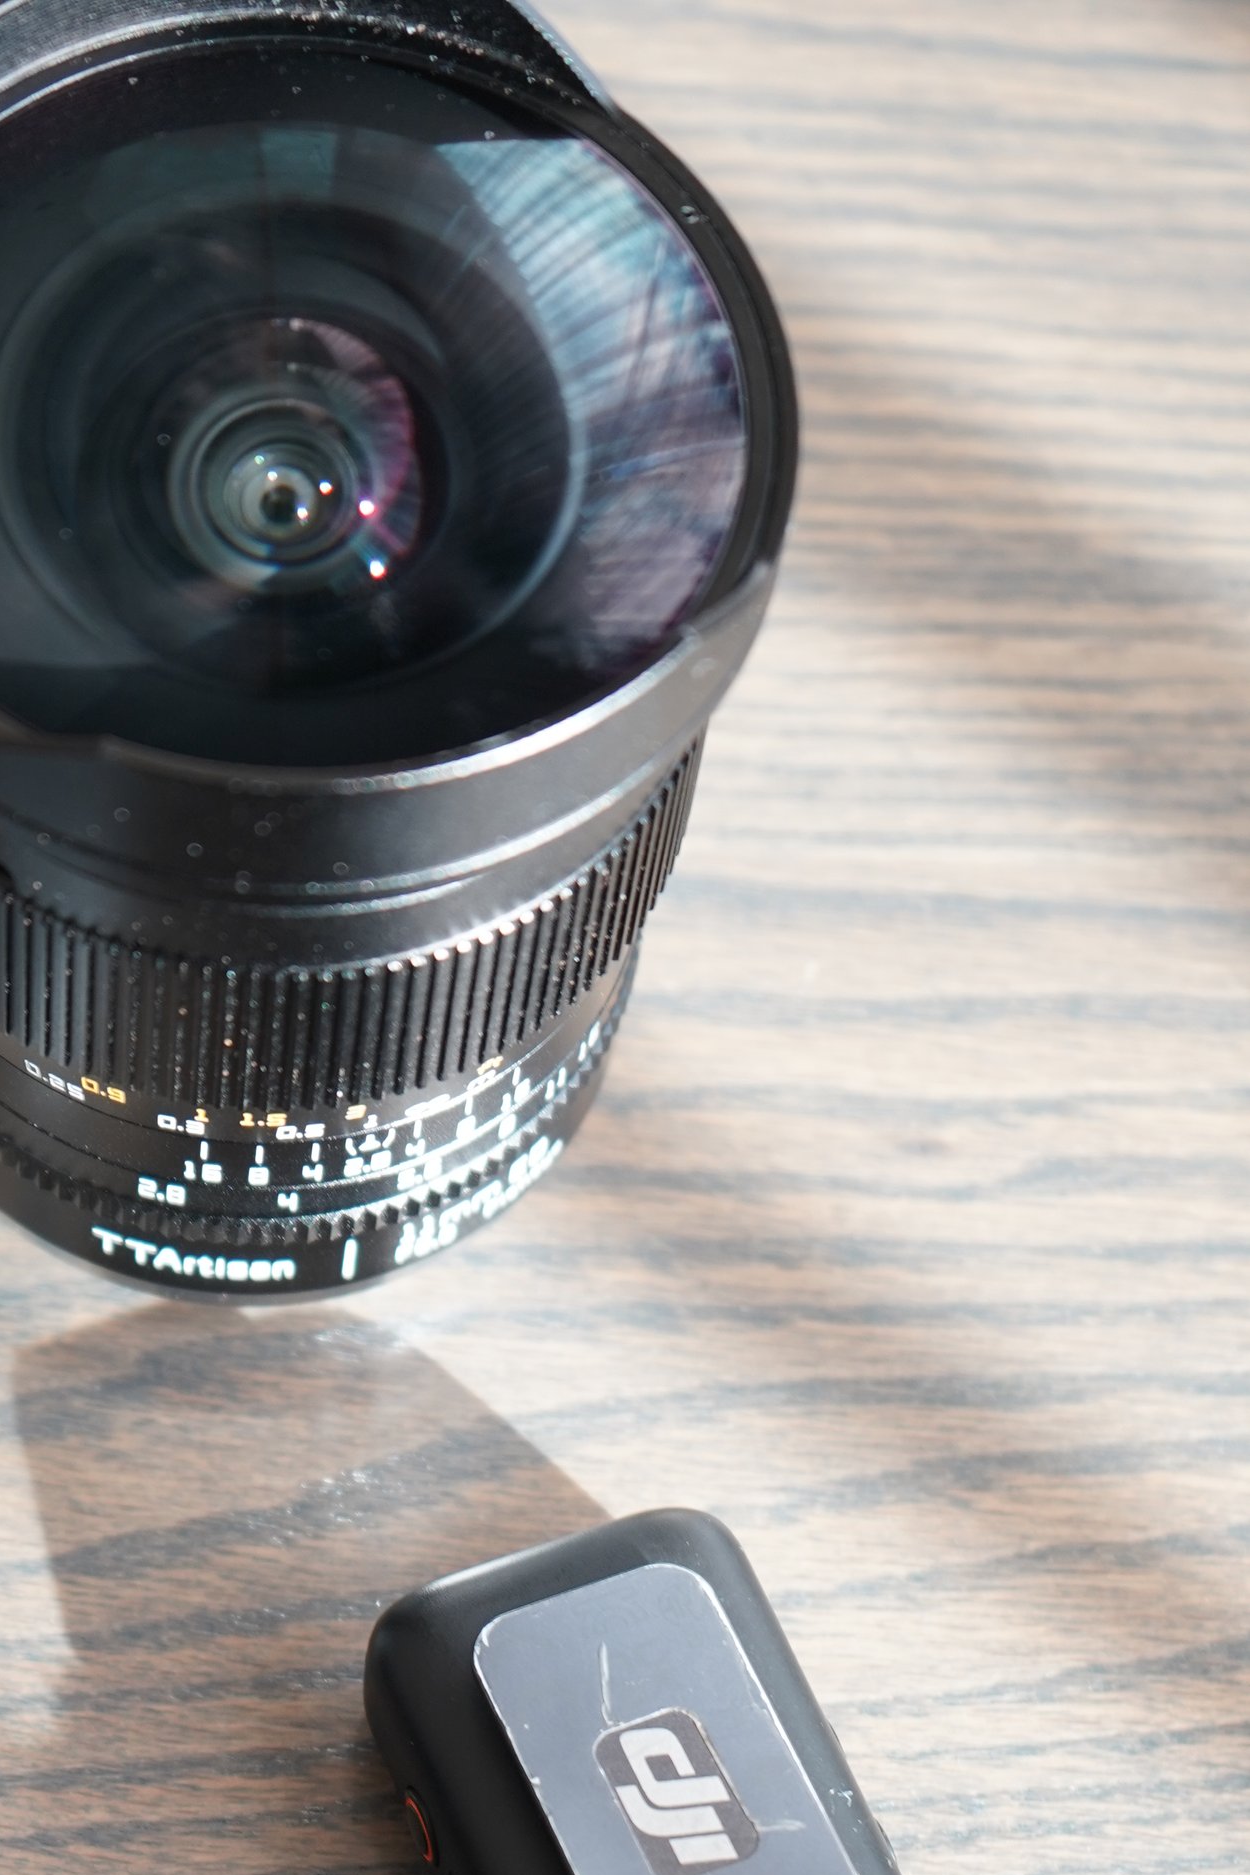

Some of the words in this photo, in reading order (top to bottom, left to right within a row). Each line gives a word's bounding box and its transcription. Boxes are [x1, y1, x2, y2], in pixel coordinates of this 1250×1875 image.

[24, 1059, 85, 1101] 0.25
[157, 1114, 205, 1136] 0.3
[276, 1123, 325, 1140] 0.5
[81, 1076, 126, 1104] 0.9
[194, 1108, 209, 1123] 1
[240, 1112, 287, 1127] 1.5
[137, 1176, 186, 1206] 2.8
[277, 1192, 299, 1213] 4
[184, 1160, 222, 1183] 16
[248, 1166, 269, 1186] 8
[302, 1164, 324, 1182] 4
